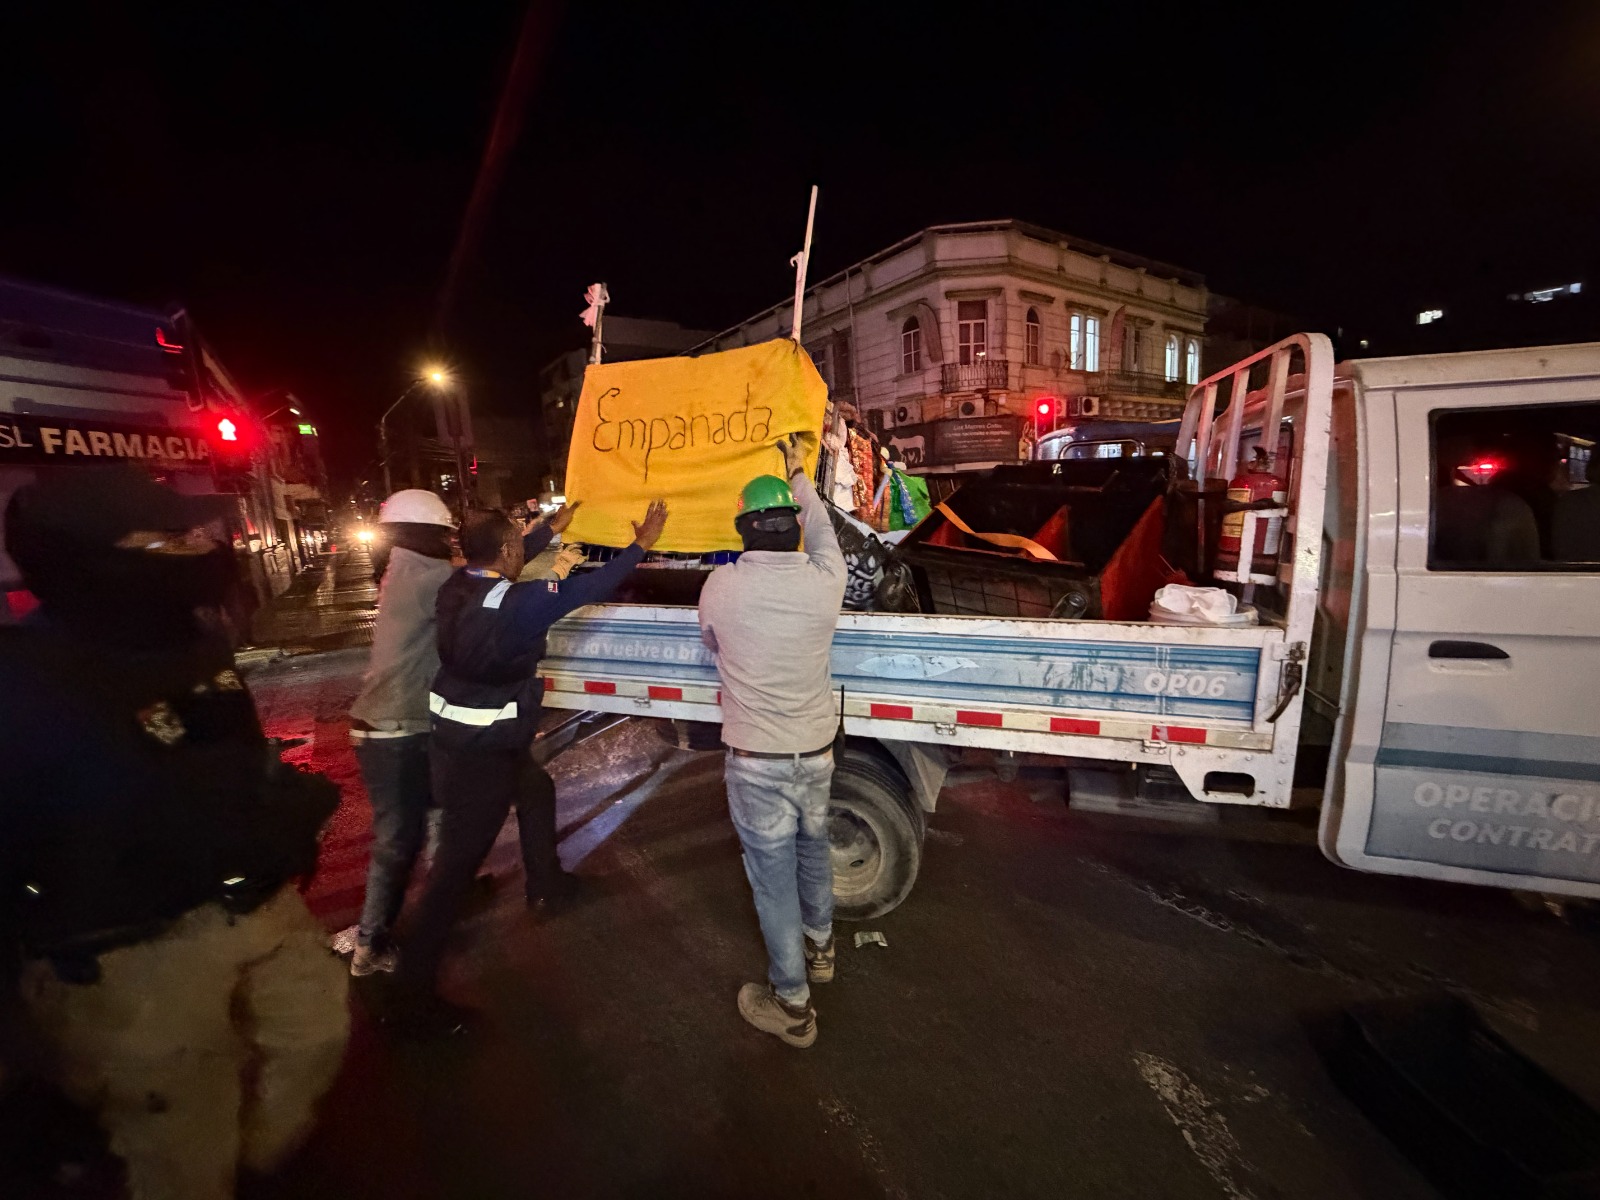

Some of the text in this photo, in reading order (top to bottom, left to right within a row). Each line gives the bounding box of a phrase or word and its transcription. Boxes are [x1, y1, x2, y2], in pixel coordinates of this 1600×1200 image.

[40, 426, 210, 461] FARMACIA
[593, 382, 773, 483] Empanada
[602, 640, 660, 658] vuelve
[663, 647, 674, 660] a
[1143, 672, 1227, 697] OP06
[1413, 781, 1600, 821] OPERACI
